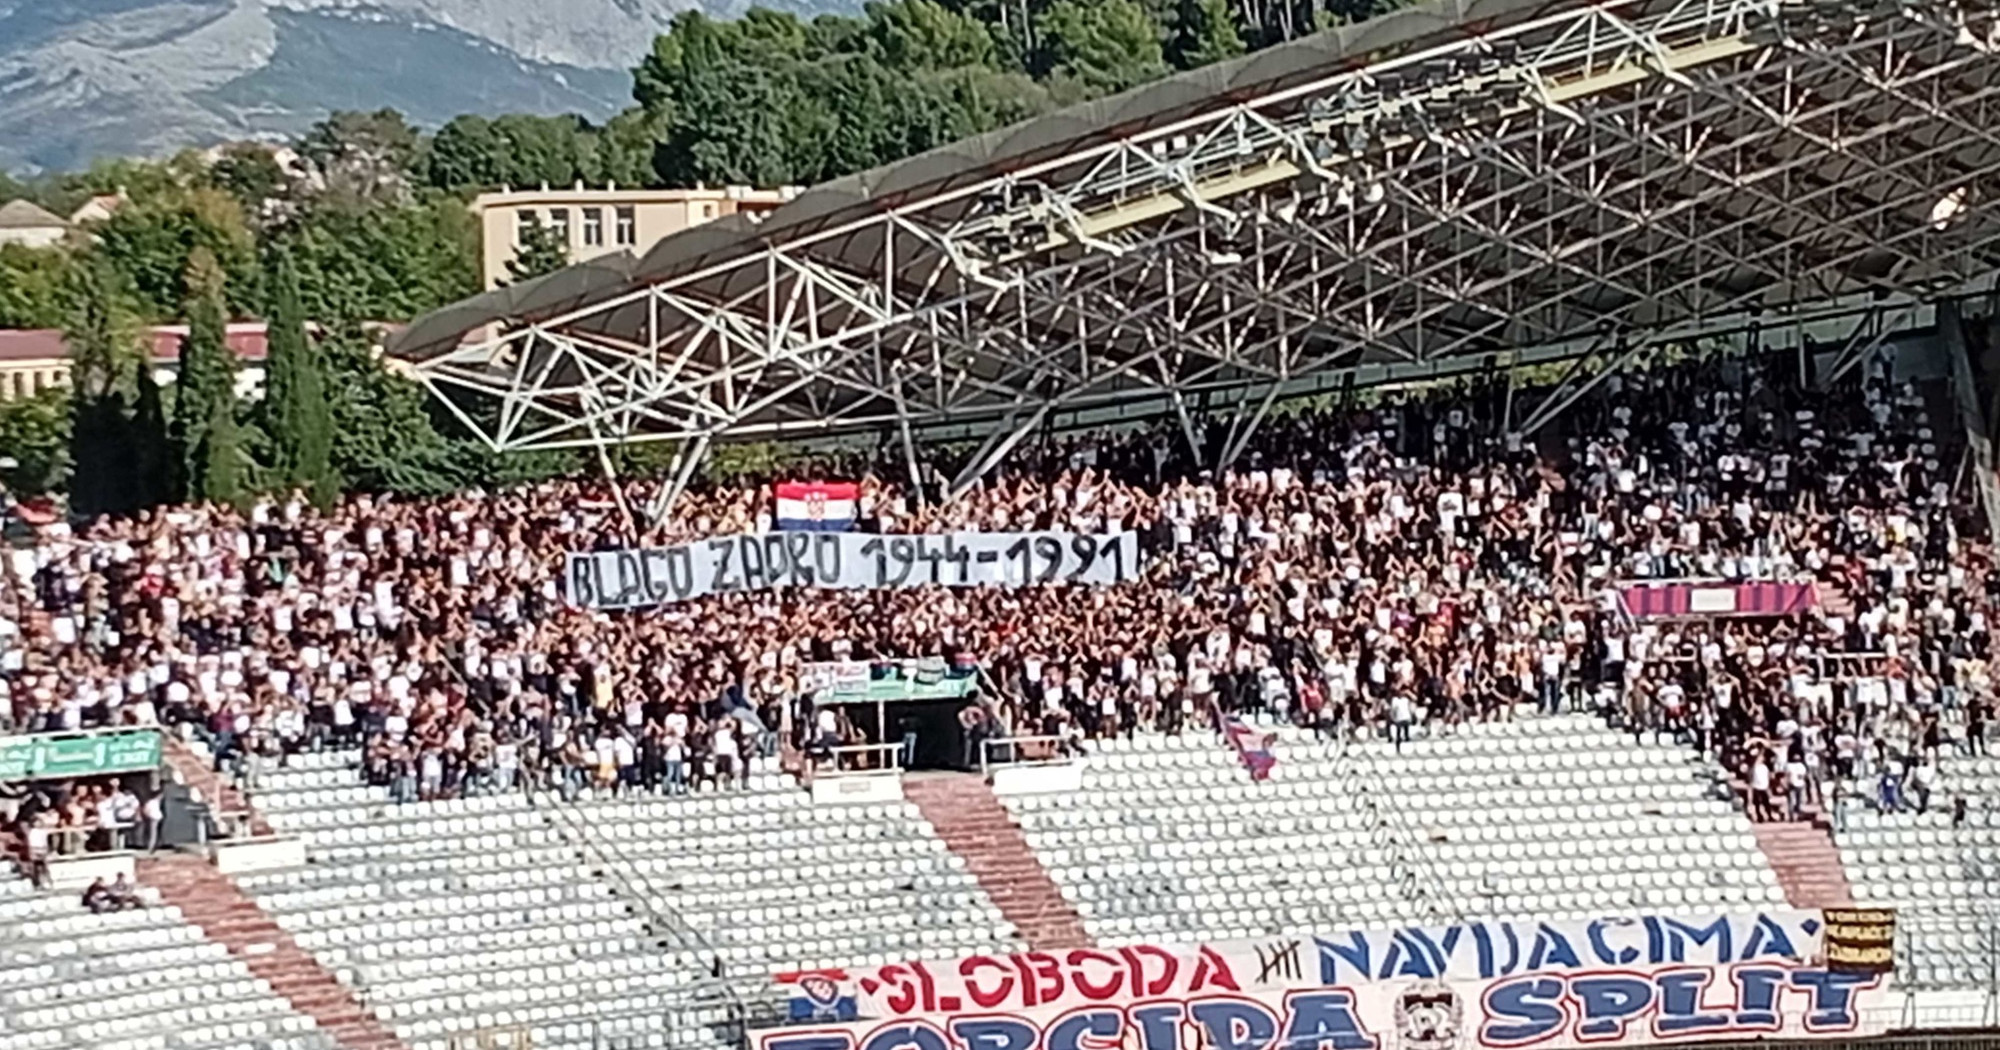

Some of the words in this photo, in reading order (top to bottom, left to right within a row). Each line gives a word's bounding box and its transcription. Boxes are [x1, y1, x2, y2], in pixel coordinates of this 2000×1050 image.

[573, 546, 694, 606] BLAGO
[762, 988, 1381, 1050] CIDA
[1480, 964, 1882, 1048] SPLIT
[878, 944, 1241, 1013] SLOBODA
